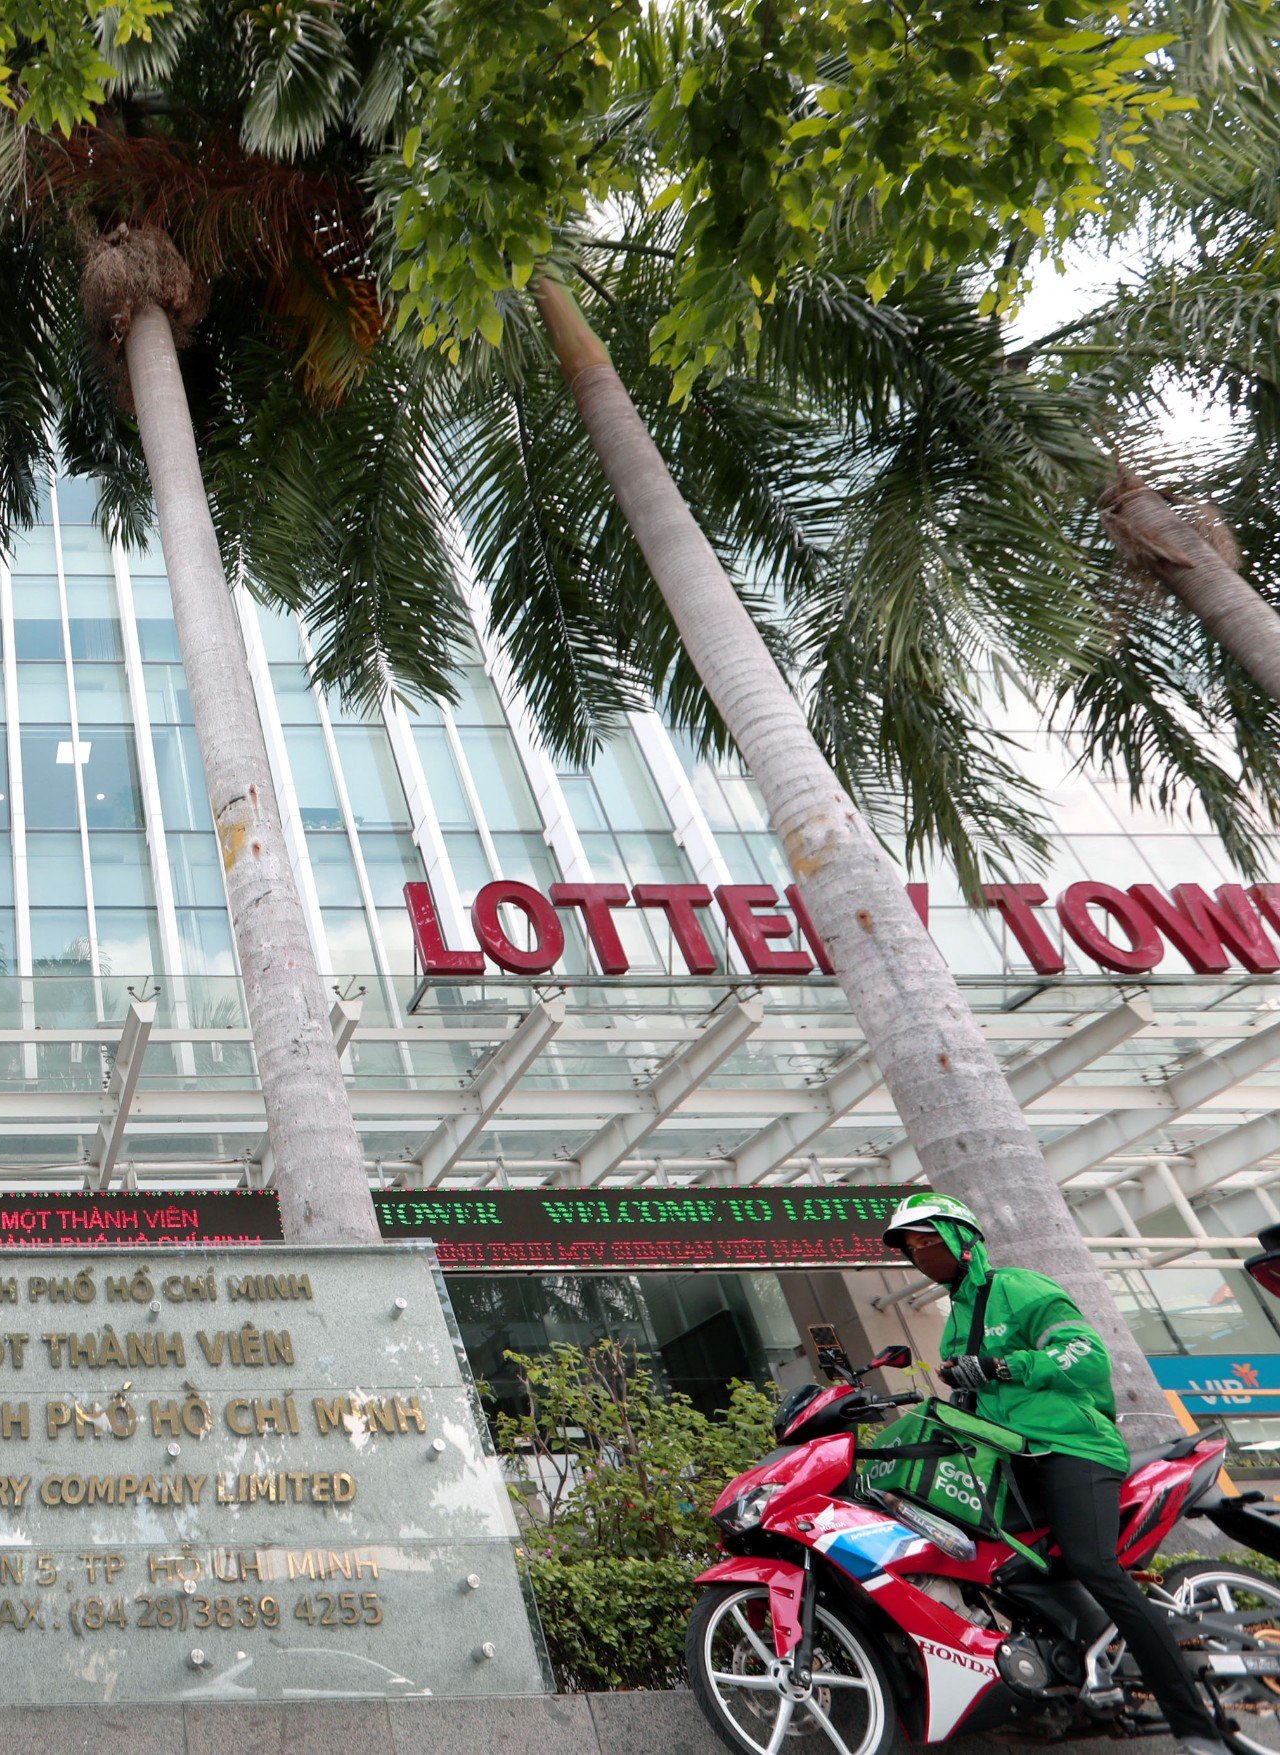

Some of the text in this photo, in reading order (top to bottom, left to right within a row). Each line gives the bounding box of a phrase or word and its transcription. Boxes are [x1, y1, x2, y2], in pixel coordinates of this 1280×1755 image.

[404, 880, 1280, 976] LOTTE TOW
[0, 1208, 55, 1233] MỘT
[56, 1206, 139, 1229] THÀNH
[142, 1205, 200, 1228] VIÊN
[782, 1198, 907, 1220] LOTTE
[29, 1266, 97, 1303] PHỐ
[106, 1265, 155, 1303] HỒ
[163, 1266, 218, 1302] CHÍ
[225, 1273, 314, 1301] MINH
[41, 1323, 187, 1369] THÀNH
[196, 1320, 296, 1367] VIÊN
[46, 1381, 138, 1439] PHỐ
[151, 1381, 215, 1438] HỒ
[225, 1388, 301, 1437] CHÍ
[312, 1395, 427, 1435] MINH
[1188, 1379, 1252, 1405] VIB
[40, 1472, 207, 1507] COMPANY
[218, 1471, 357, 1506] LIMITED
[78, 1552, 126, 1585] TP
[287, 1550, 380, 1582] MINH
[294, 1592, 385, 1626] 4255
[918, 1641, 1001, 1680] HONDA
